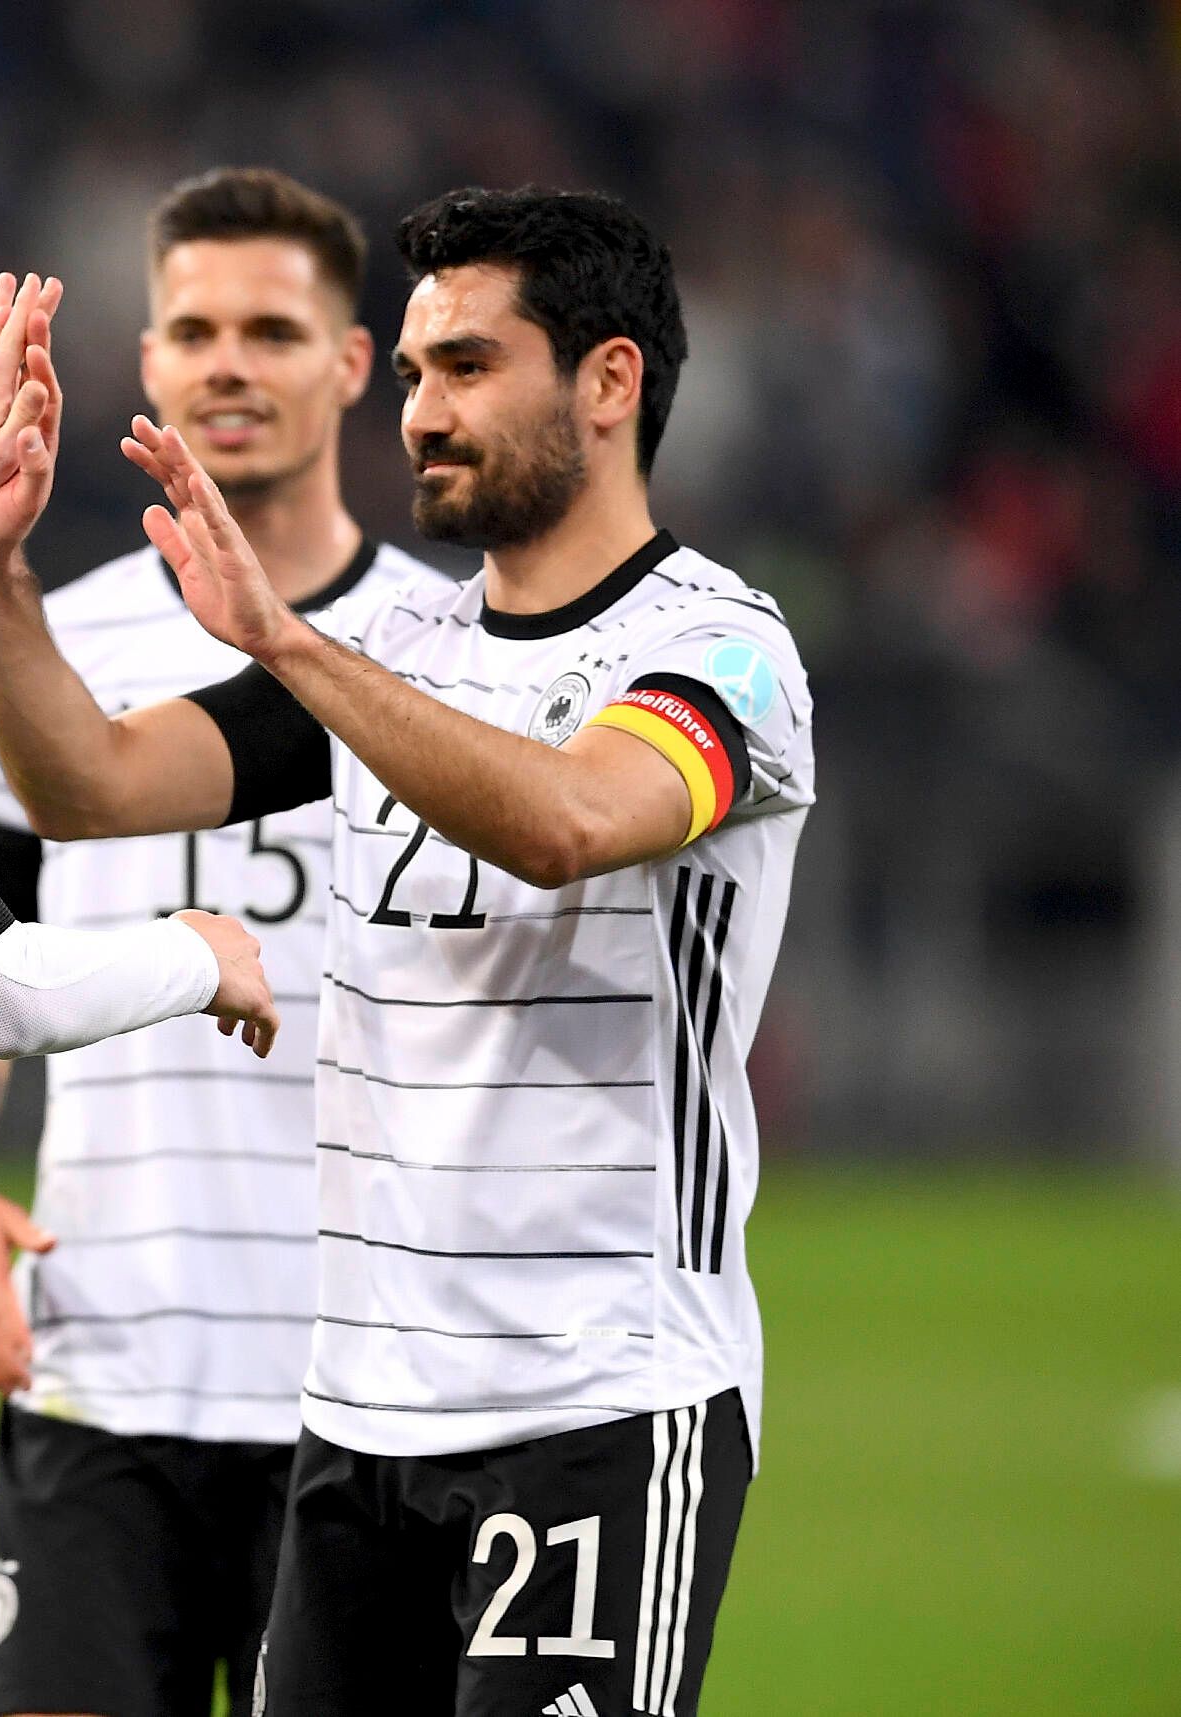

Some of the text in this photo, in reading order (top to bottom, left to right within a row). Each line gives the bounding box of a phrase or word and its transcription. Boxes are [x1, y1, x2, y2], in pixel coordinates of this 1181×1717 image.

[157, 817, 307, 923] 15
[368, 794, 488, 929] 21
[466, 1513, 616, 1659] 21
